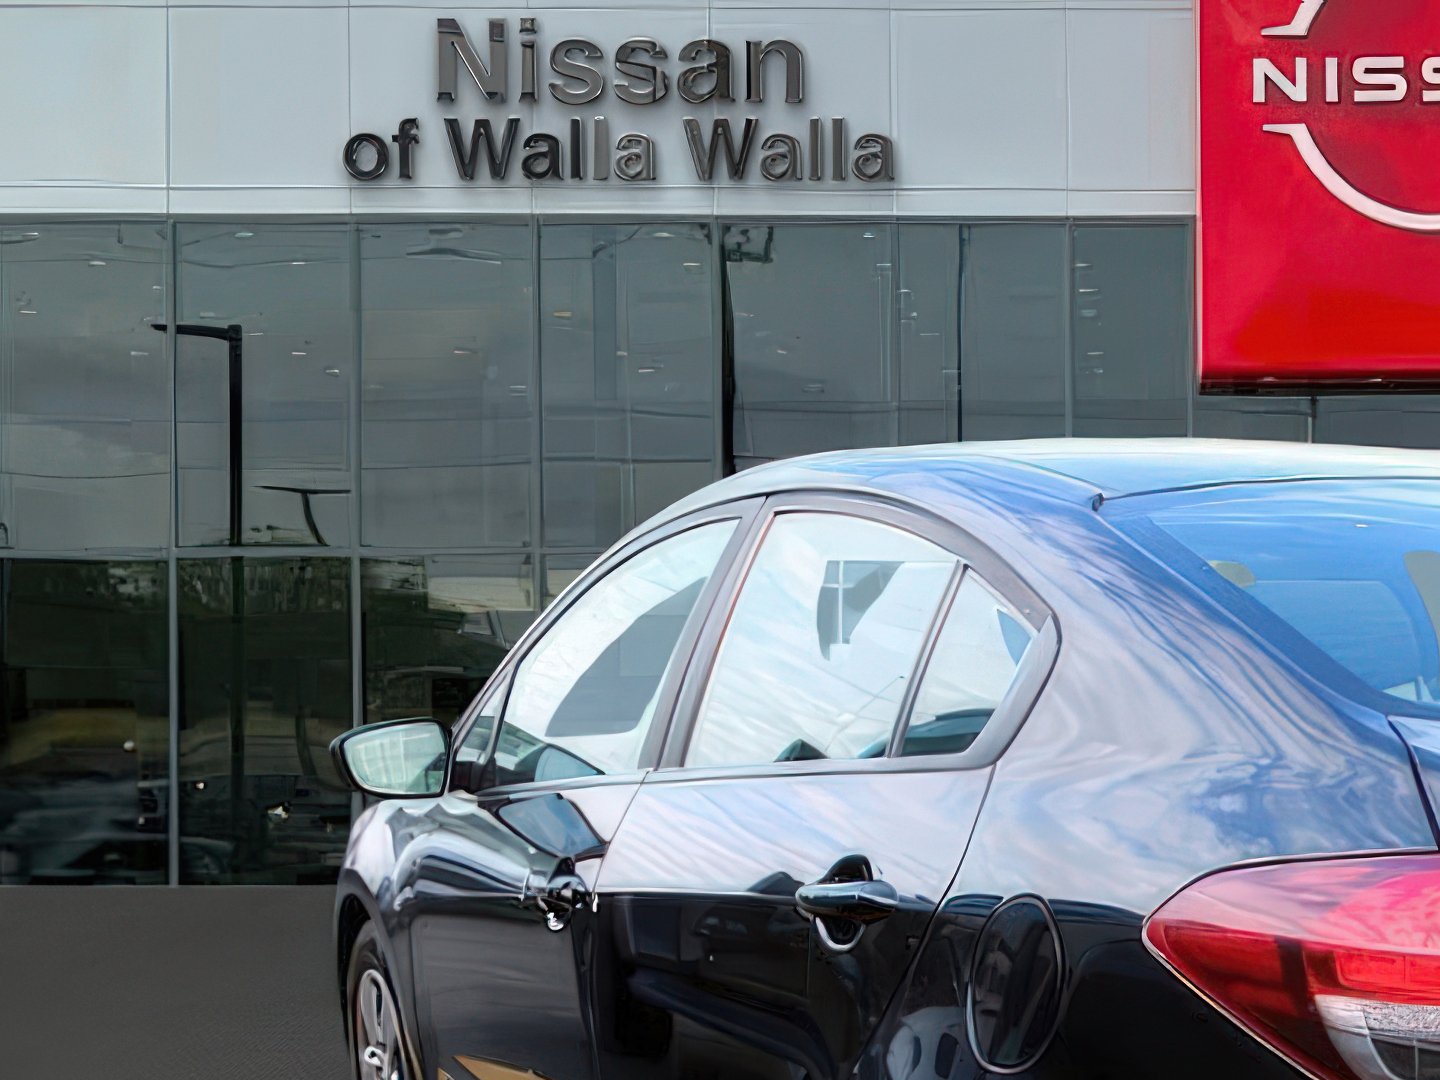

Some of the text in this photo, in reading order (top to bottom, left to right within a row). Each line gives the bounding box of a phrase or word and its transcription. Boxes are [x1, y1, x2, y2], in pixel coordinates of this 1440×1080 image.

[436, 17, 804, 104] Nissan
[342, 116, 895, 181] of Walla Walla
